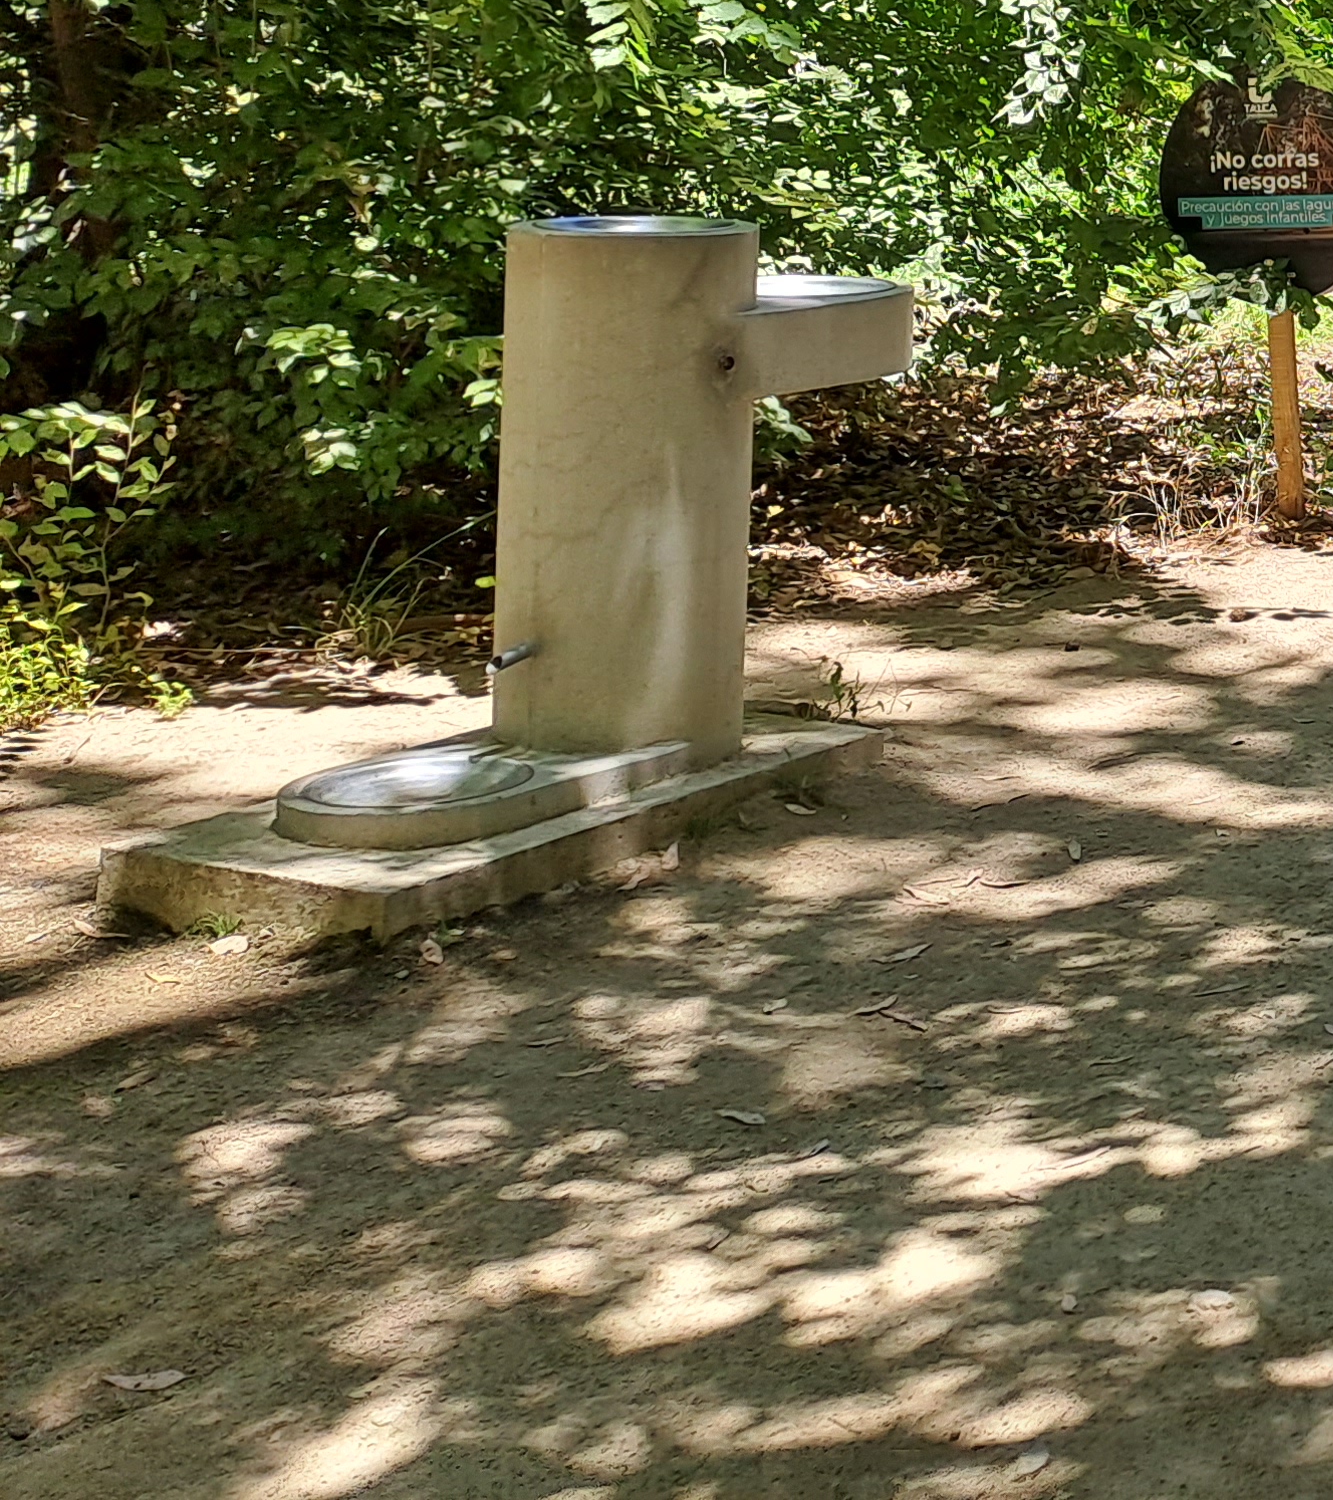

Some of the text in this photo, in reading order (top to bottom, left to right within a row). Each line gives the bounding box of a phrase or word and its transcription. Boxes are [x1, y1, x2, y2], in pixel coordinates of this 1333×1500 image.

[1243, 103, 1278, 114] TALCA
[1210, 151, 1319, 173] ¡No corras
[1223, 171, 1308, 194] riesgos!
[1181, 199, 1252, 214] Precaución
[1255, 201, 1279, 212] con
[1282, 199, 1300, 212] las
[1207, 214, 1216, 225] y
[1220, 212, 1264, 227] juegos
